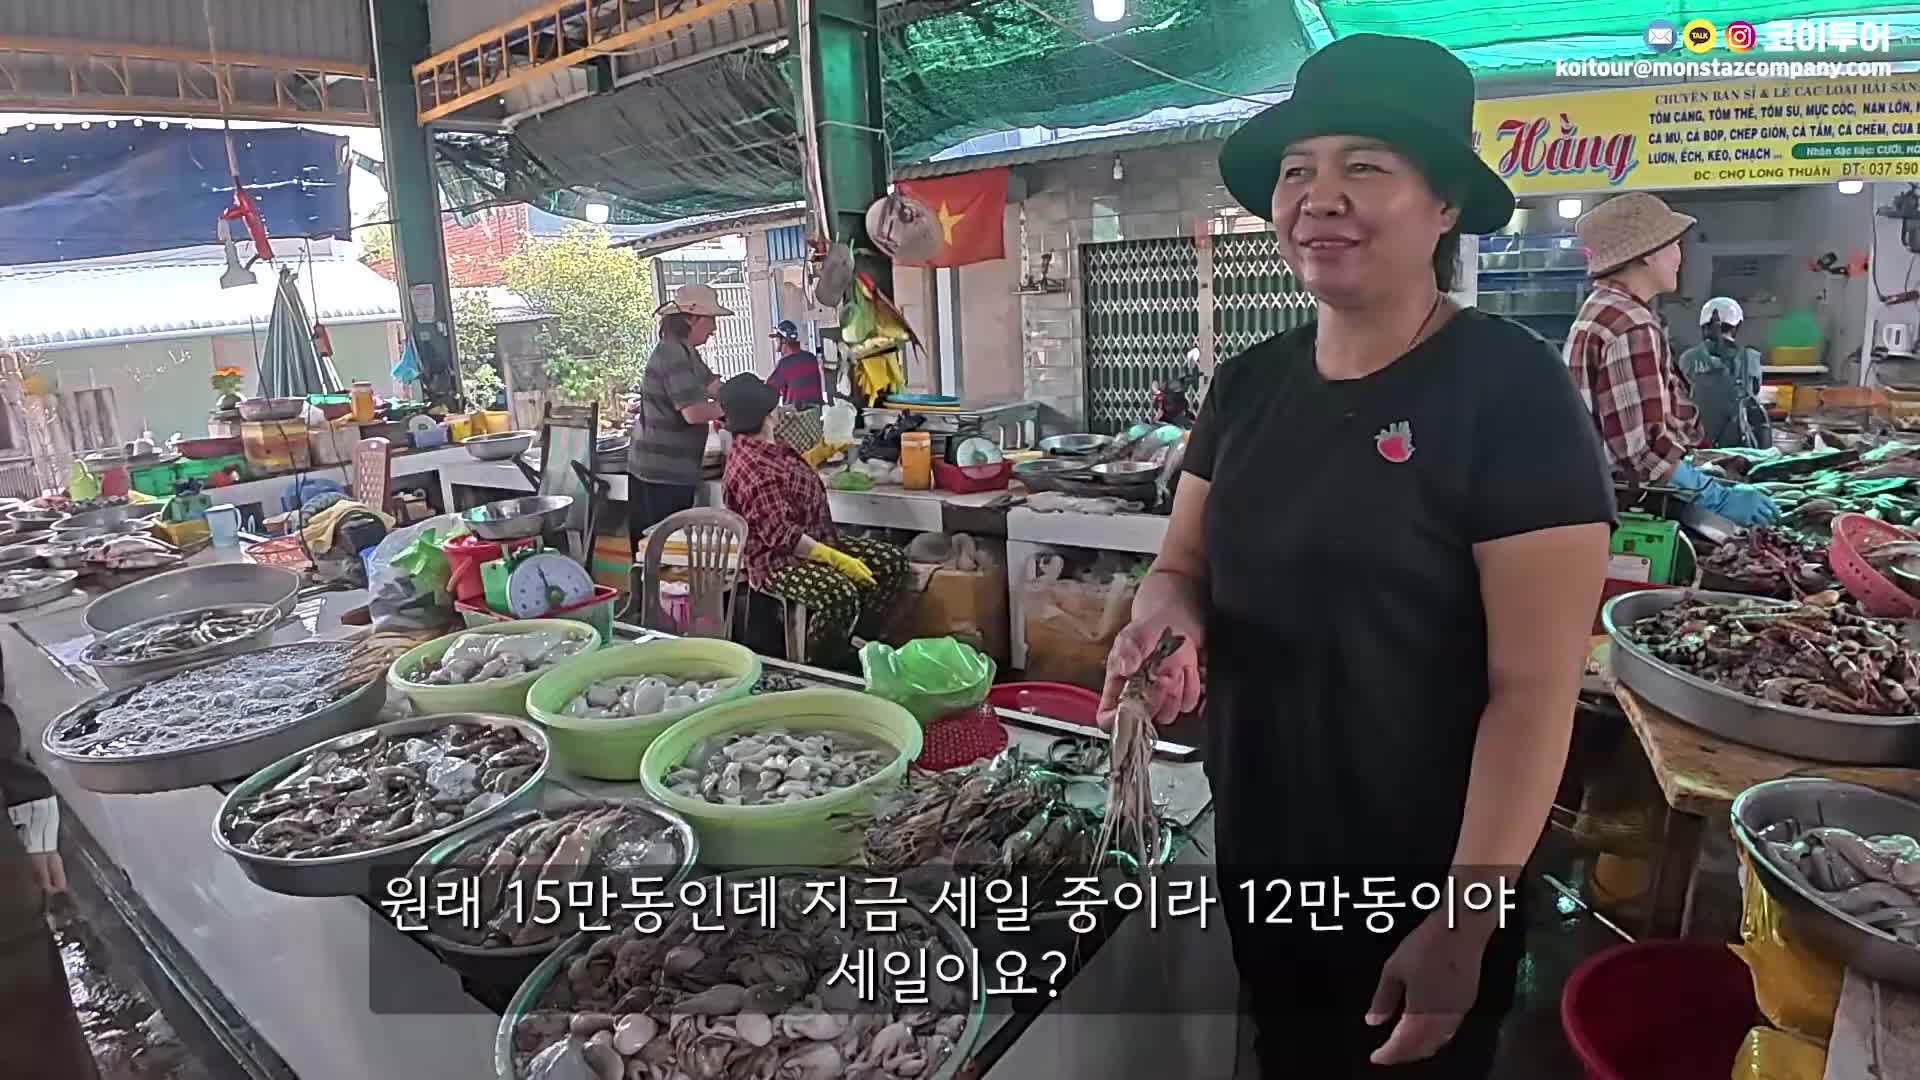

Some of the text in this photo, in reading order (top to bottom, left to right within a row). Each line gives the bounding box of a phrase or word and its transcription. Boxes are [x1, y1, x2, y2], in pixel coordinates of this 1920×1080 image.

[1892, 122, 1913, 135] CUA
[1749, 167, 1784, 179] LONG
[1868, 162, 1893, 176] 037
[1895, 162, 1919, 176] 590
